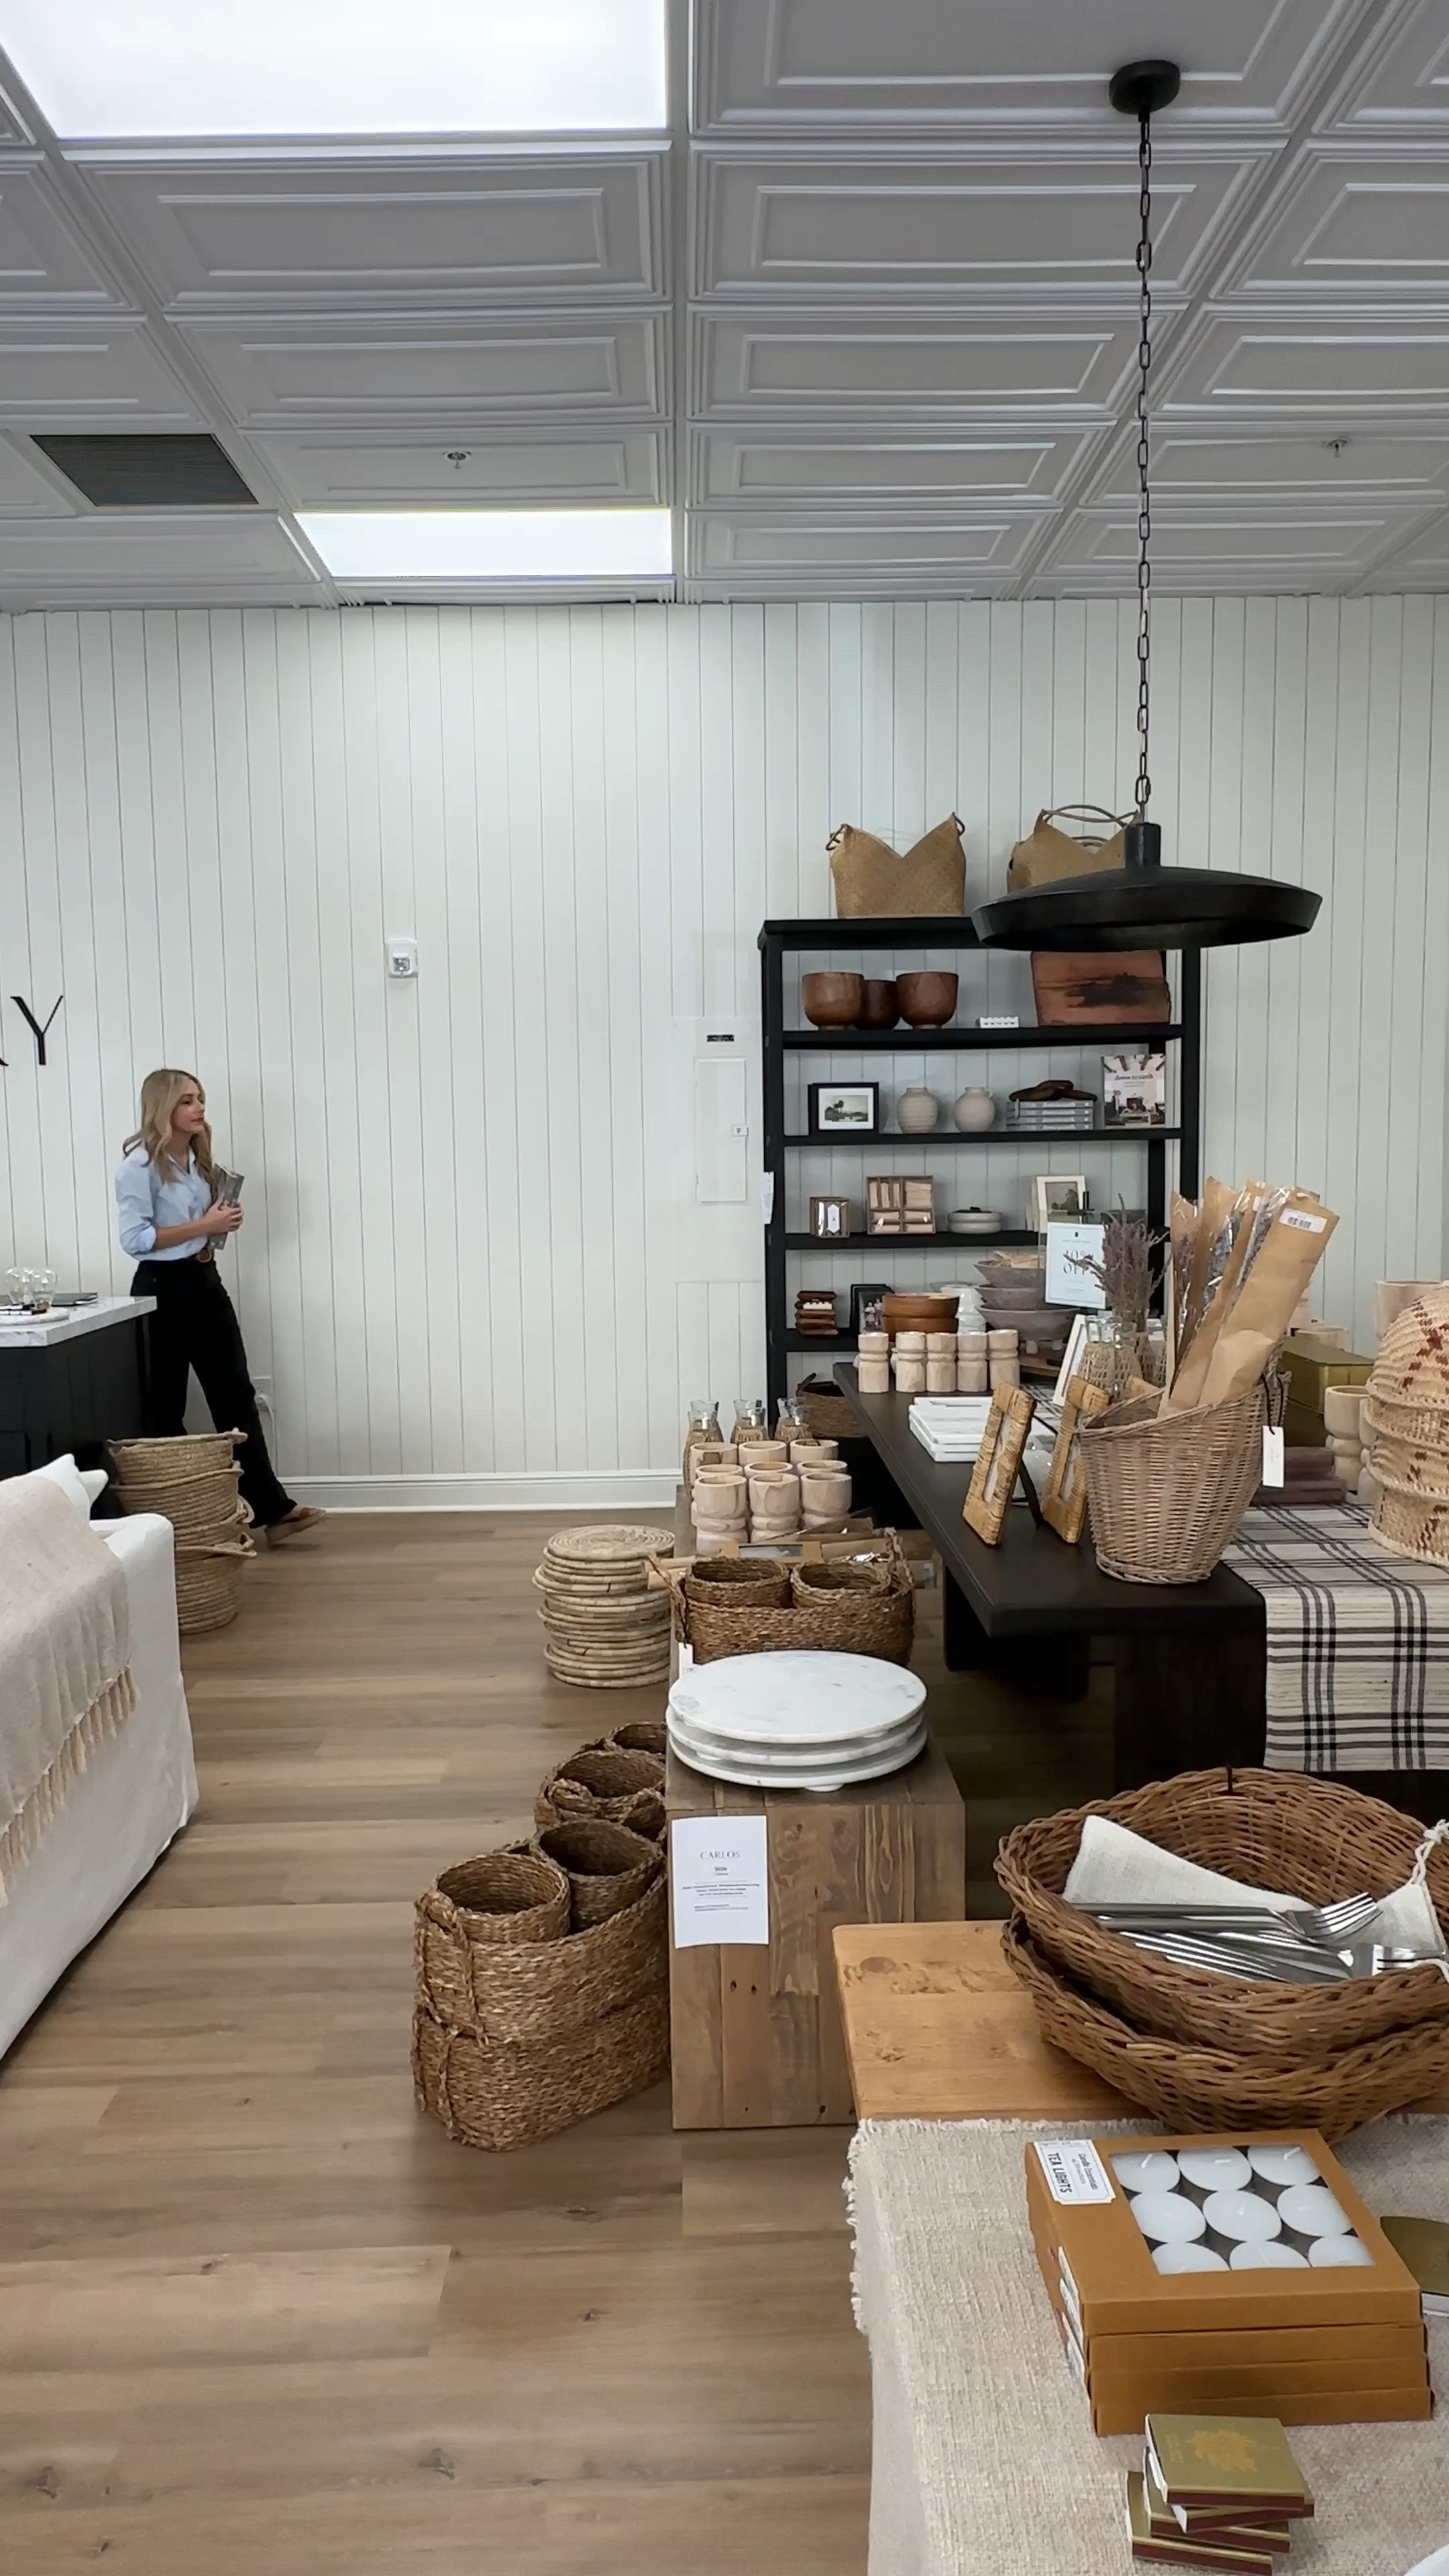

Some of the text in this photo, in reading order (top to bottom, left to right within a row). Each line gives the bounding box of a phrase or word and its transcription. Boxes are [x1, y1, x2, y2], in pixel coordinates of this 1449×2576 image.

[0, 996, 64, 1067] Y
[1048, 2153, 1062, 2166] TEA
[1053, 2168, 1073, 2193] LIGHTS
